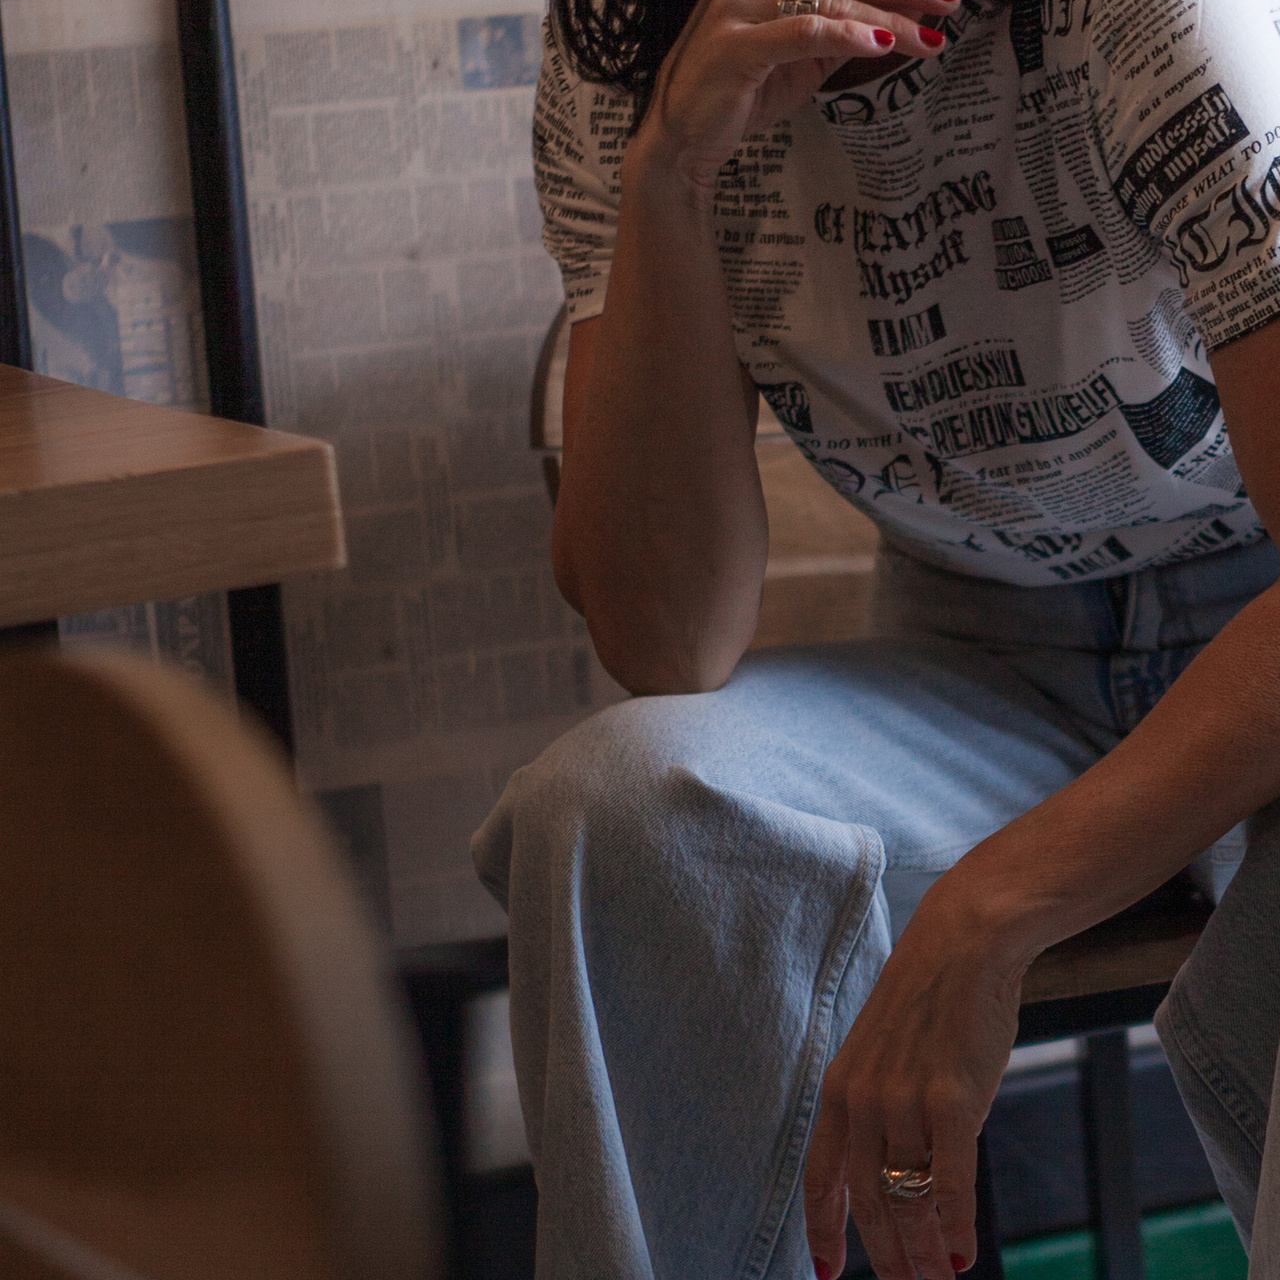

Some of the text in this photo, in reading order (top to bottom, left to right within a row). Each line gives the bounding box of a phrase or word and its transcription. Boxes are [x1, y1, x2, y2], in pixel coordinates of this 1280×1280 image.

[1151, 41, 1170, 61] the
[1169, 22, 1195, 46] Fear
[1153, 53, 1175, 78] and
[1138, 106, 1152, 122] do
[1151, 96, 1162, 110] it
[953, 129, 973, 143] and
[1163, 112, 1238, 183] myself.
[1193, 157, 1237, 200] WHAT
[1240, 140, 1263, 163] TO
[856, 228, 970, 307] Myself
[1200, 279, 1218, 301] and
[1219, 264, 1252, 289] expect
[1266, 245, 1278, 262] it
[1223, 318, 1242, 339] you
[1242, 303, 1275, 332] going
[1225, 299, 1252, 322] your
[827, 433, 893, 450] DO WITH
[1014, 460, 1034, 474] and
